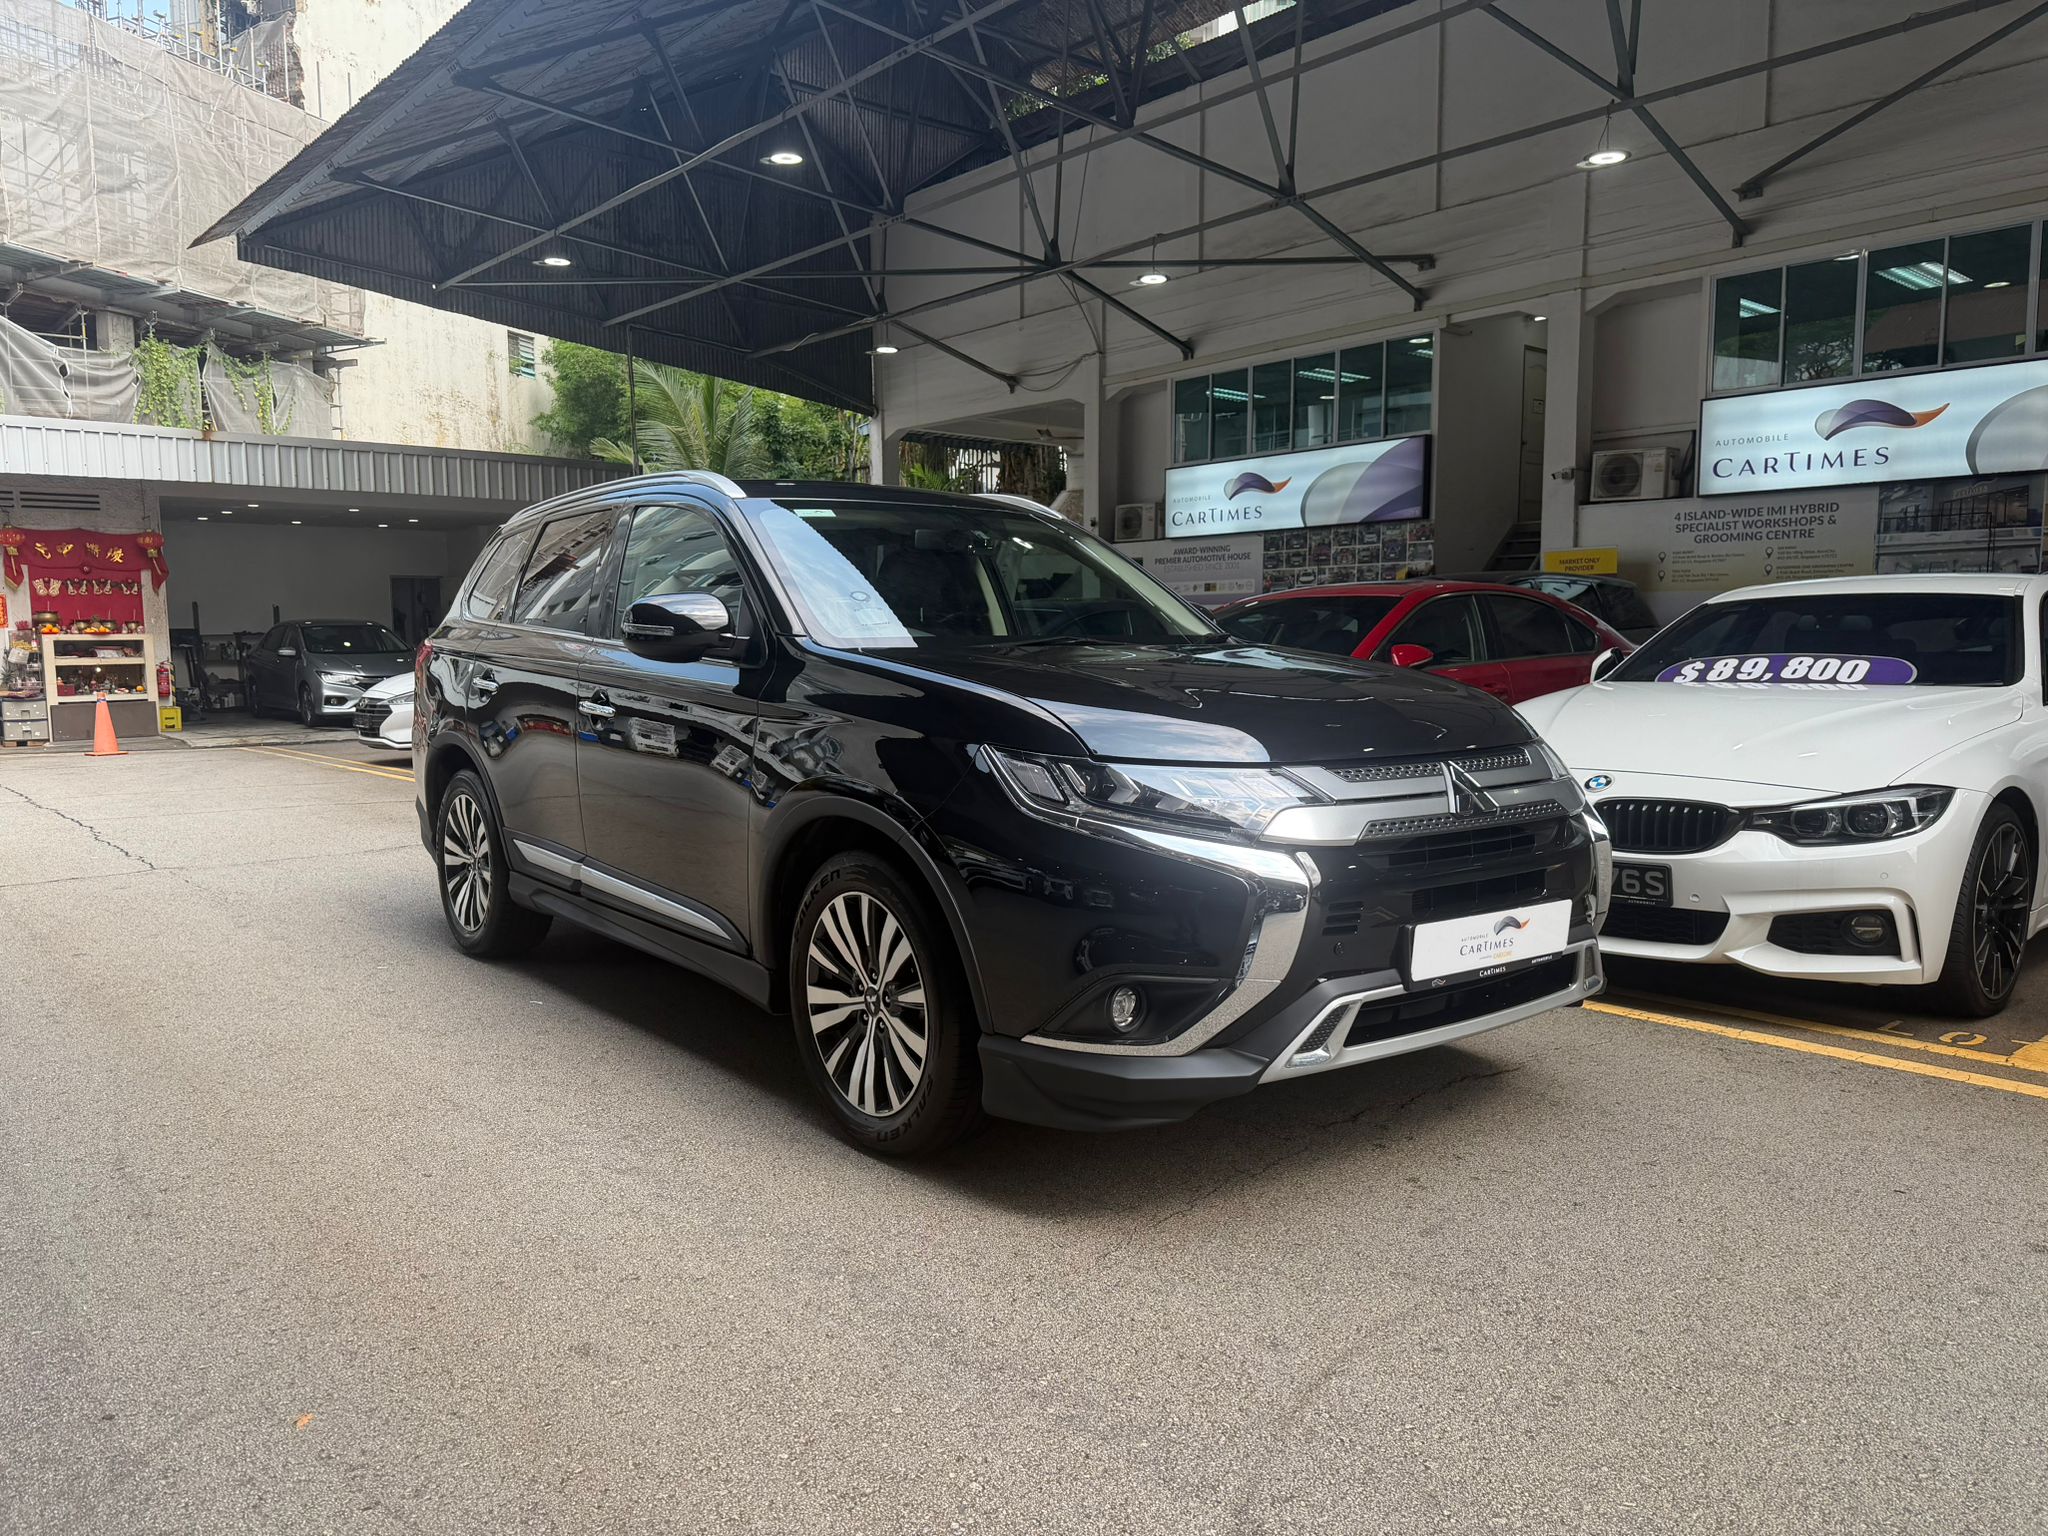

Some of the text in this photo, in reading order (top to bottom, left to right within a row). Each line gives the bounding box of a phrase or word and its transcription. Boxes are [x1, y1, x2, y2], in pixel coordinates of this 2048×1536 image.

[1715, 433, 1790, 447] AUTOMOBILE
[1712, 446, 1890, 479] CARTIMES
[1173, 495, 1211, 504] AUTOMOBILE
[1172, 505, 1263, 527] CARTIMES
[1674, 502, 1840, 522] 4 ISLAND-WIDE IMI HYBRID
[1675, 514, 1838, 534] SPECIALIST WORKSHOPS &
[1694, 528, 1815, 544] GROOMING CENTRE
[1155, 551, 1251, 565] PREMIER AUTOMOTIVE HOUSE
[1173, 544, 1231, 556] AWARD-WINNING
[1673, 656, 1871, 683] $89,800
[1459, 937, 1515, 957] CARTIMES
[1479, 965, 1506, 978] CARTIMES
